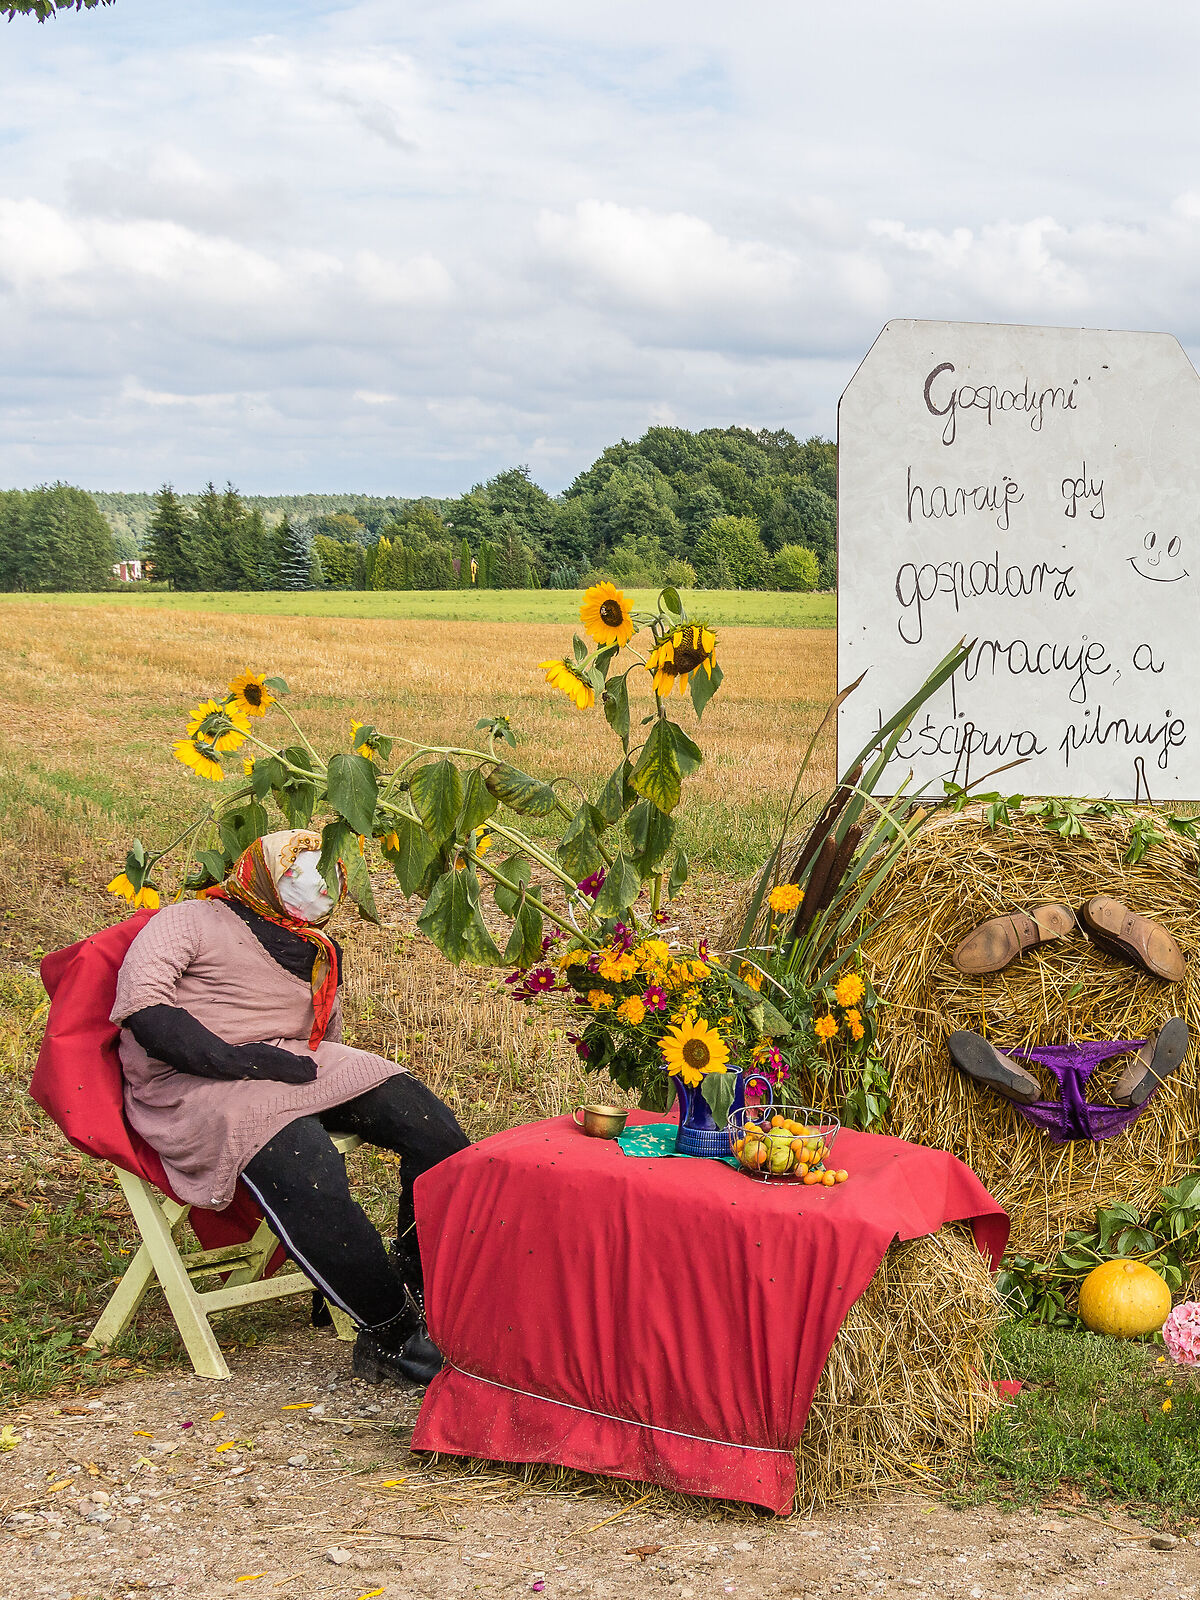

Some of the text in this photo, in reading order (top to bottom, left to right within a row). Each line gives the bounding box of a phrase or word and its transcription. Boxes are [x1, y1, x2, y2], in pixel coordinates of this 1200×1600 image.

[923, 361, 1079, 447] Gospodyni
[1061, 460, 1105, 520] gdy
[895, 550, 1076, 645] gospodarz
[1132, 643, 1165, 675] a
[1058, 704, 1187, 770] pilnuje
